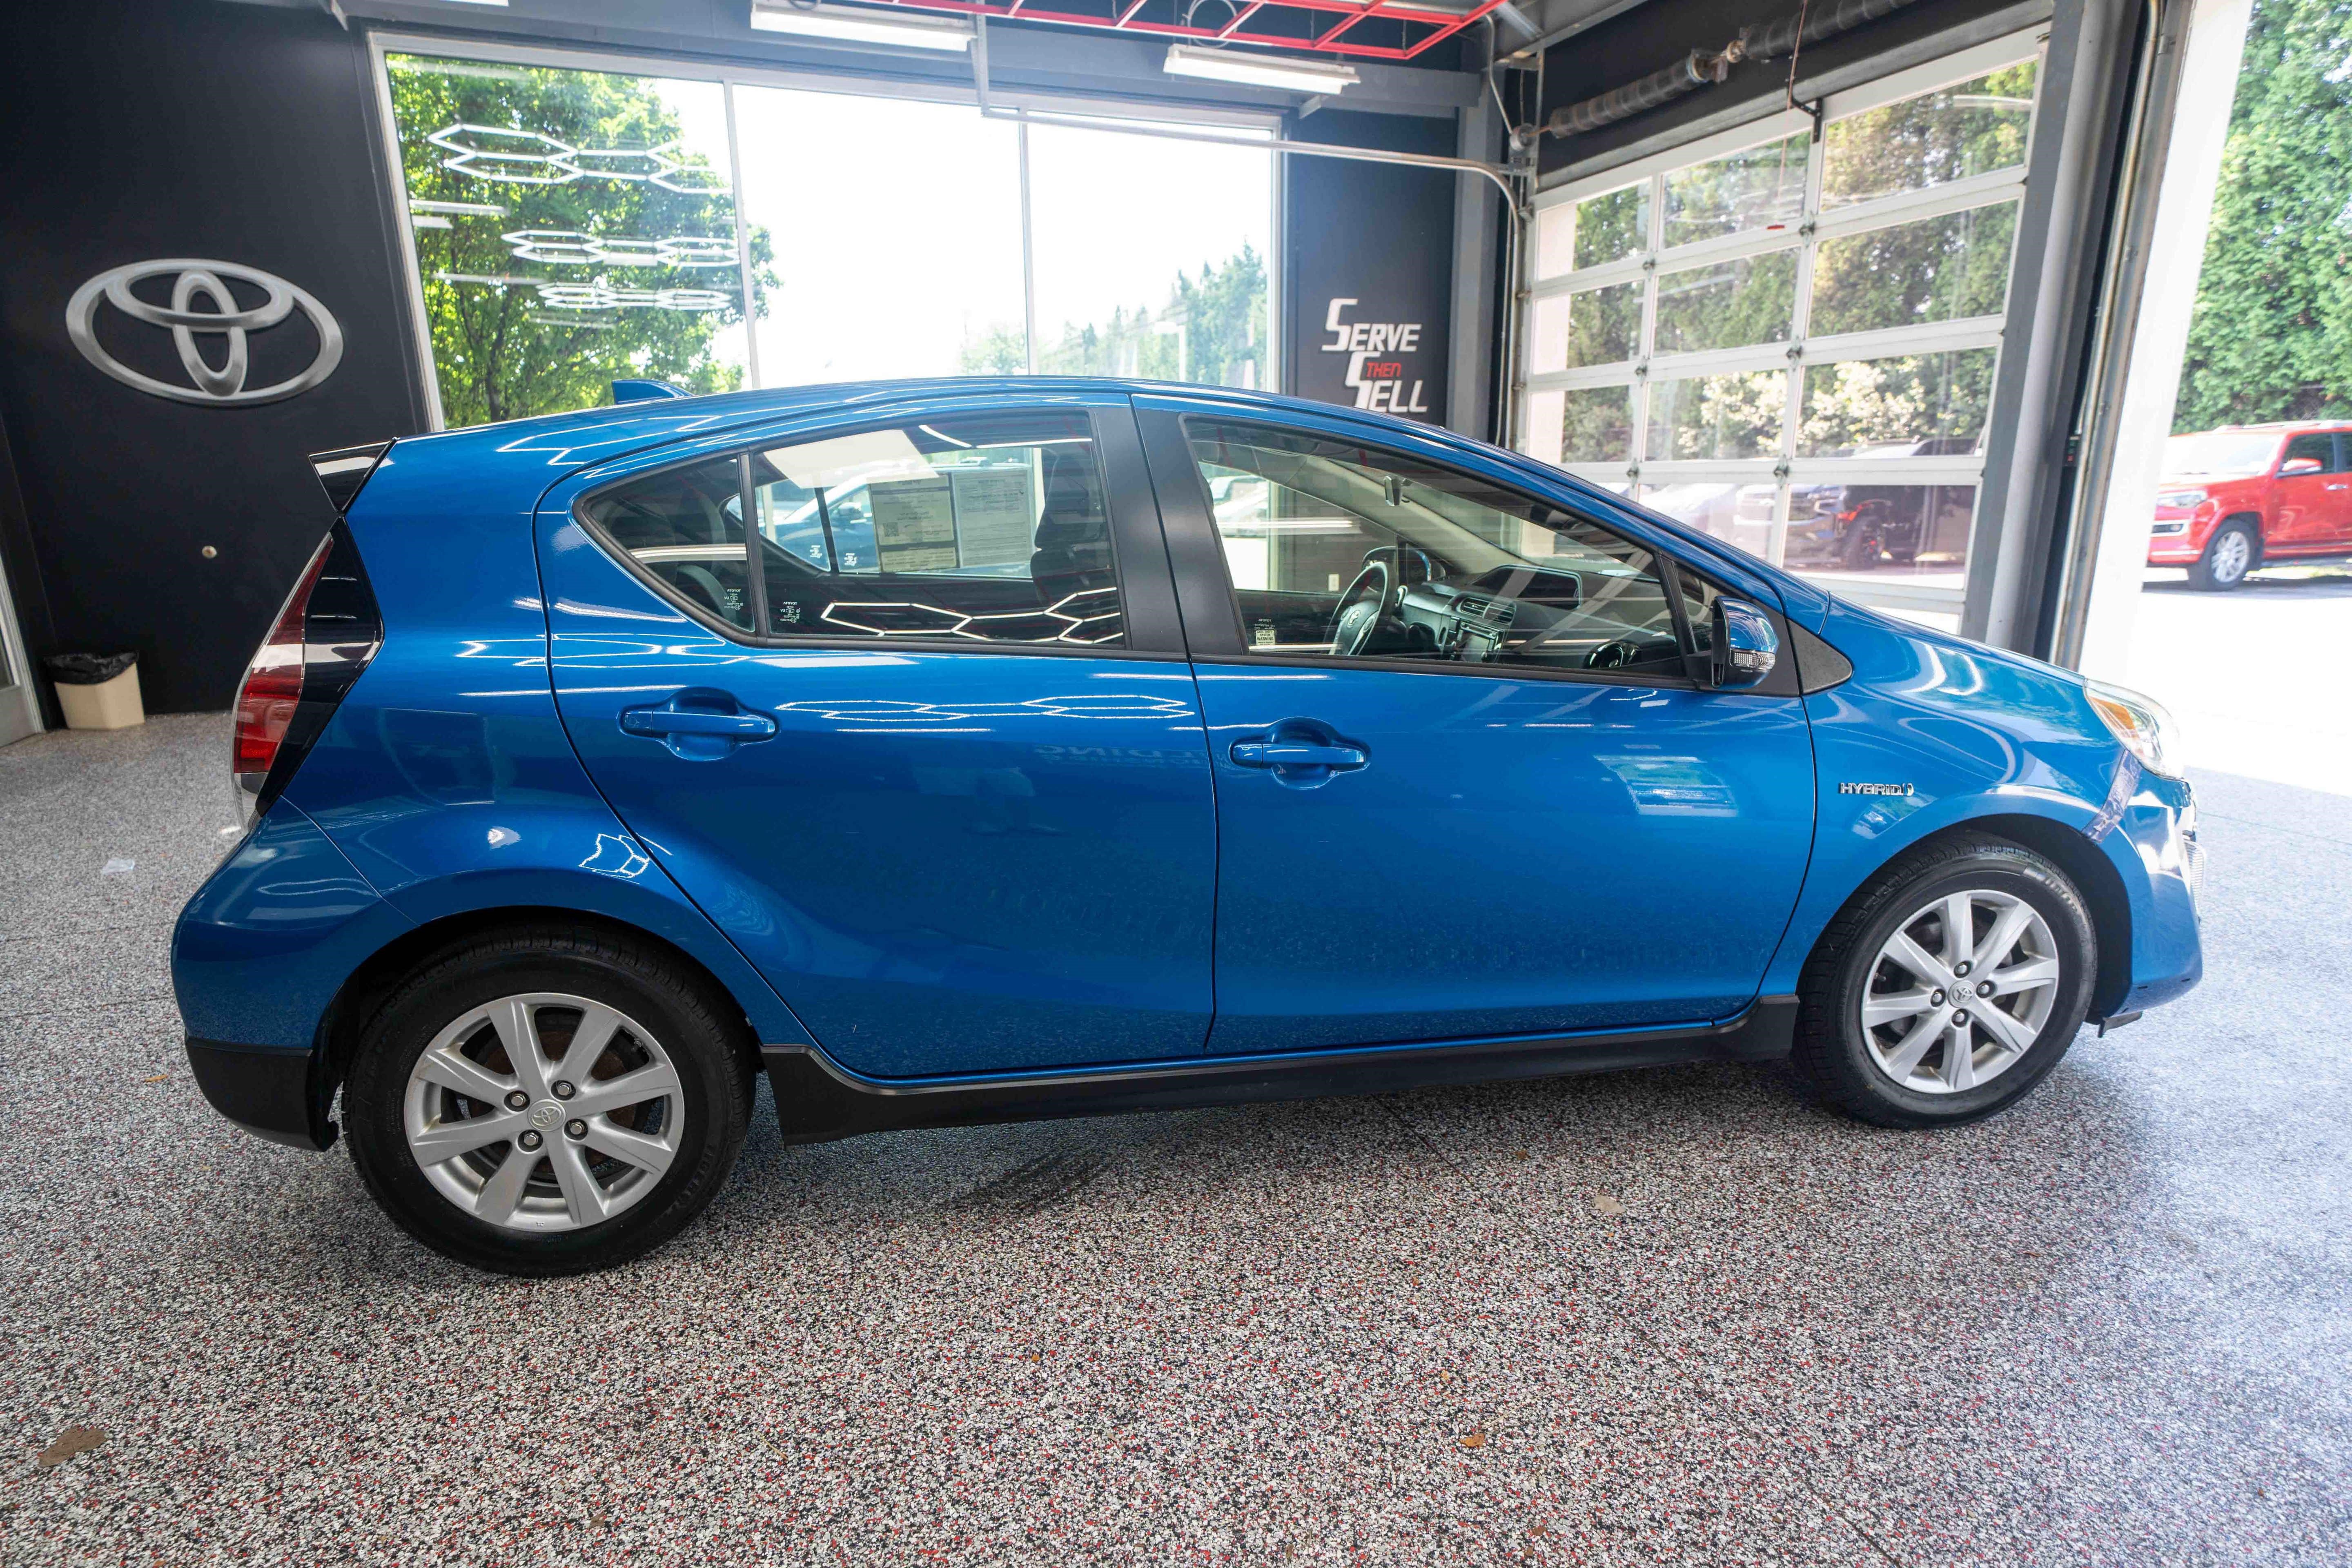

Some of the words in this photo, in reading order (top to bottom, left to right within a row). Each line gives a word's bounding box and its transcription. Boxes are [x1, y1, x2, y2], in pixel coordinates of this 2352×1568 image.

[1321, 298, 1422, 352] SERVE
[1345, 351, 1428, 413] SELL
[1366, 362, 1401, 377] THEN
[1840, 782, 1904, 795] HYBRID
